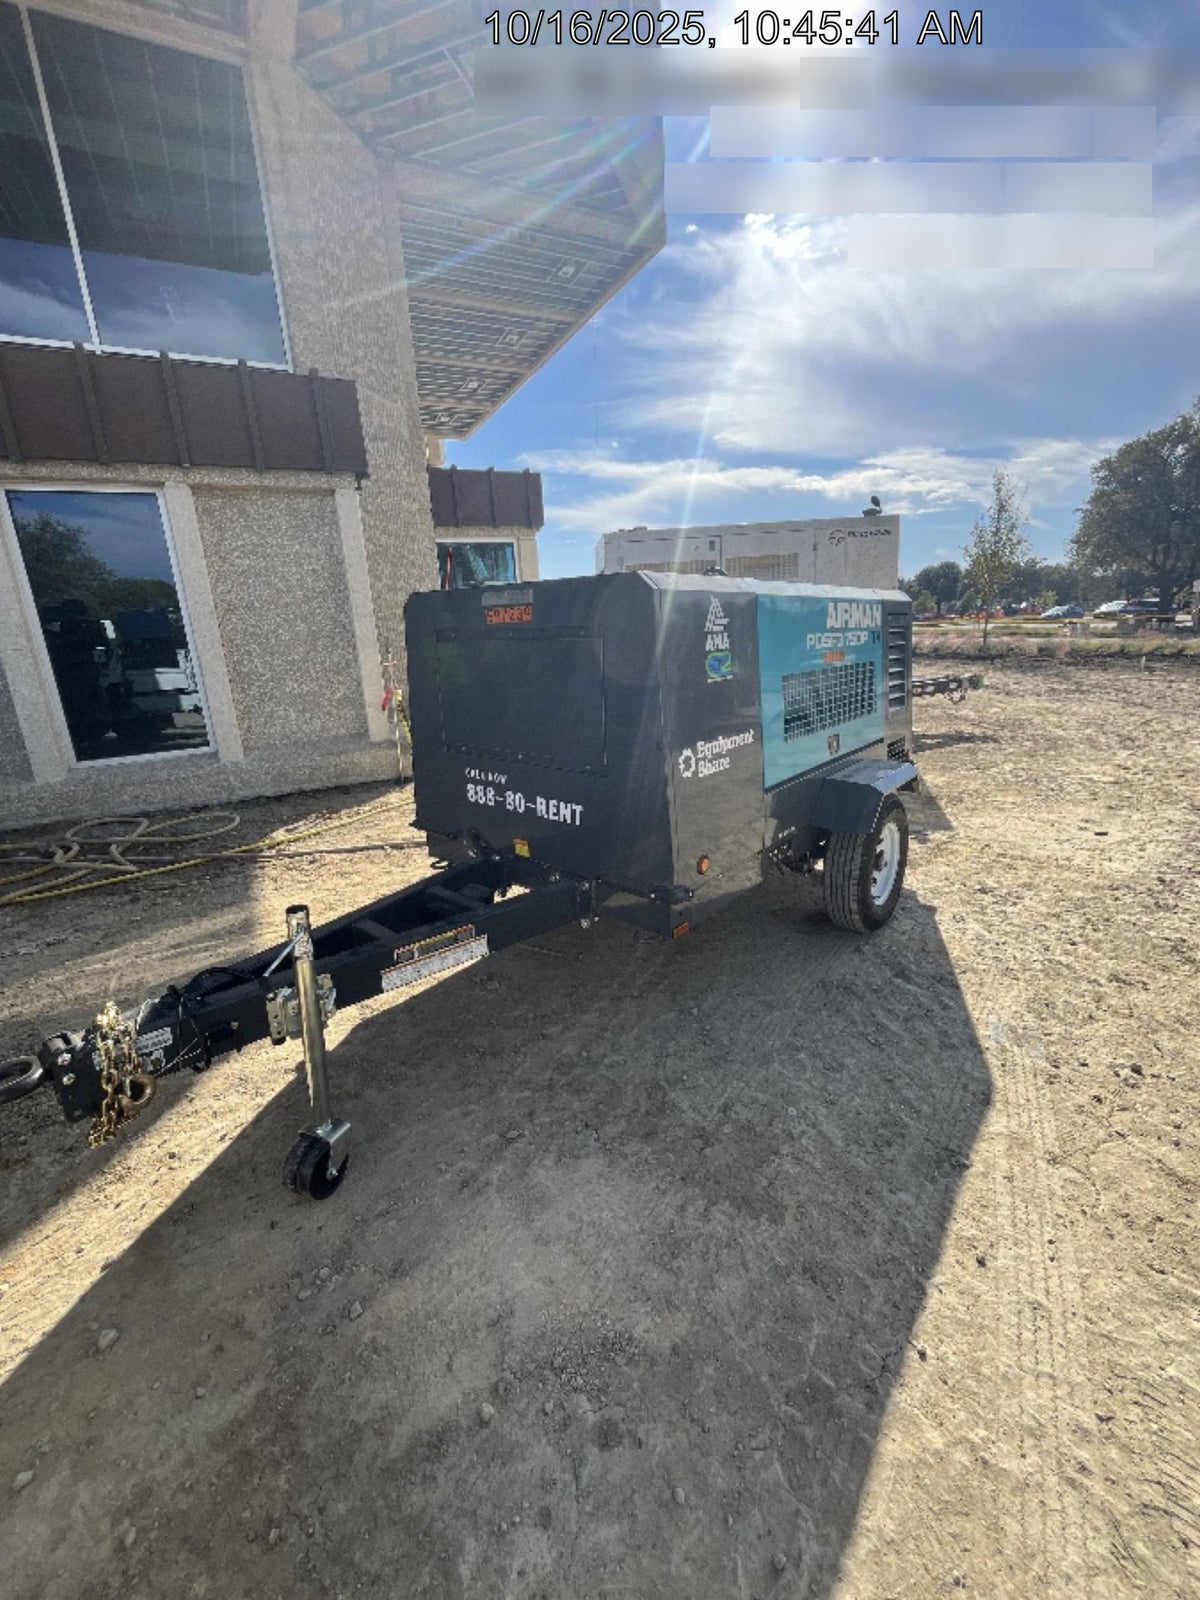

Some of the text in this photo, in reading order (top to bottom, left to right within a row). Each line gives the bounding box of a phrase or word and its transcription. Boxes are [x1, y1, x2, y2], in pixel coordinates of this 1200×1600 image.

[826, 602, 882, 628] AIRMAN
[697, 728, 755, 758] Equipment
[698, 756, 730, 777] Share
[466, 783, 584, 826] 888-80-RENT
